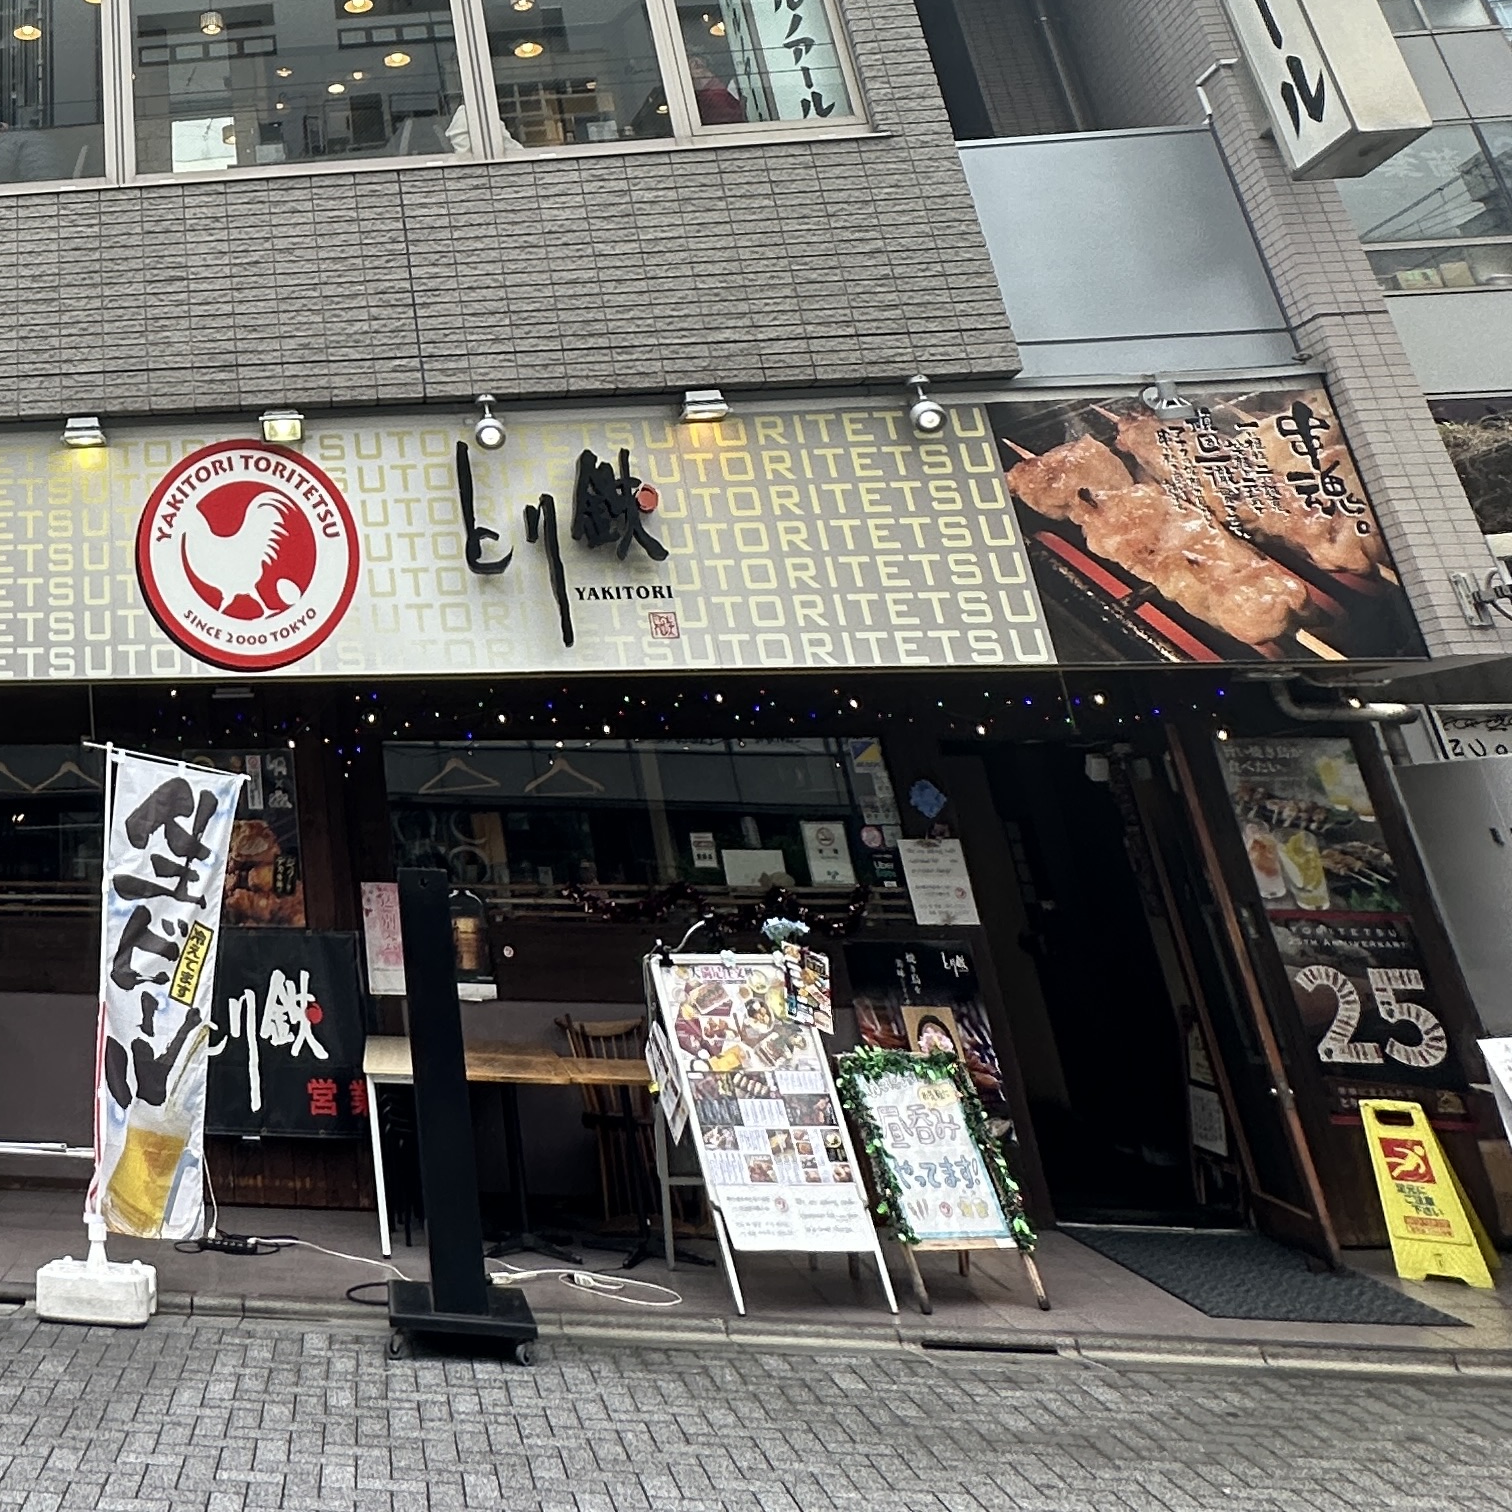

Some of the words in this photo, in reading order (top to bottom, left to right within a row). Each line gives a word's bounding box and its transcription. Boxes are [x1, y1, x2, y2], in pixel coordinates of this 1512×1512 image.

[156, 456, 234, 543] YAKITORI
[240, 454, 341, 539] TORITETSU
[455, 440, 670, 648] とり鉄
[575, 585, 674, 601] YAKITORI
[183, 609, 221, 640] SINCE
[226, 632, 268, 645] 2000
[270, 607, 317, 642] TOKYO
[1293, 964, 1448, 1069] 25
[876, 1103, 962, 1149] 昼呑み
[893, 1154, 981, 1190] やってます!
